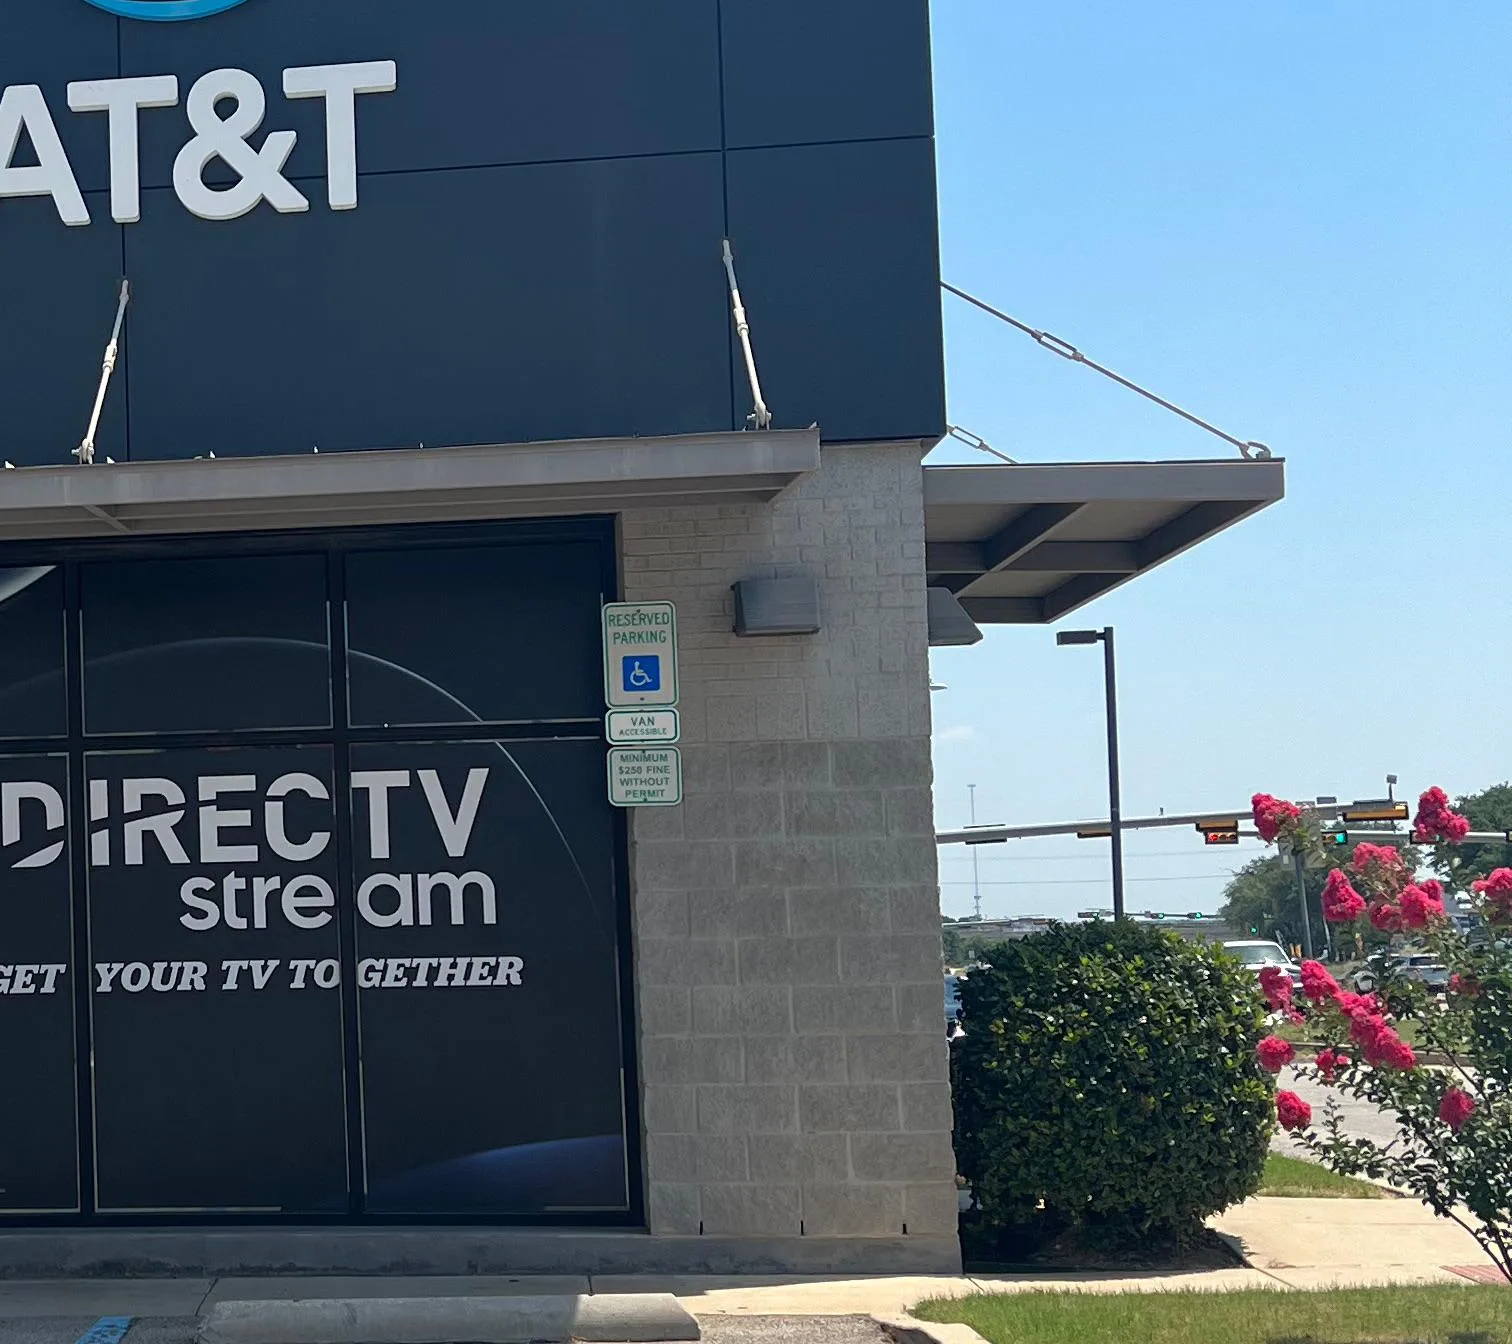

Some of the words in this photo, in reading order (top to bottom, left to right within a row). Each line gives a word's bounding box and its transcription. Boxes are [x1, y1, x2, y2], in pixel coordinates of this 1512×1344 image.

[608, 612, 670, 627] RESERVED
[613, 630, 667, 645] PARKING
[631, 716, 655, 727] VAN
[619, 728, 667, 737] ACCESSIBLE
[620, 753, 668, 763] MINIMUM
[646, 765, 671, 774] FINE
[619, 777, 670, 787] WITHOUT
[625, 789, 665, 798] PERMIT
[1, 768, 489, 869] DIRECTV
[180, 870, 497, 931] stream
[95, 960, 207, 992] YOUR
[221, 959, 280, 990] TV
